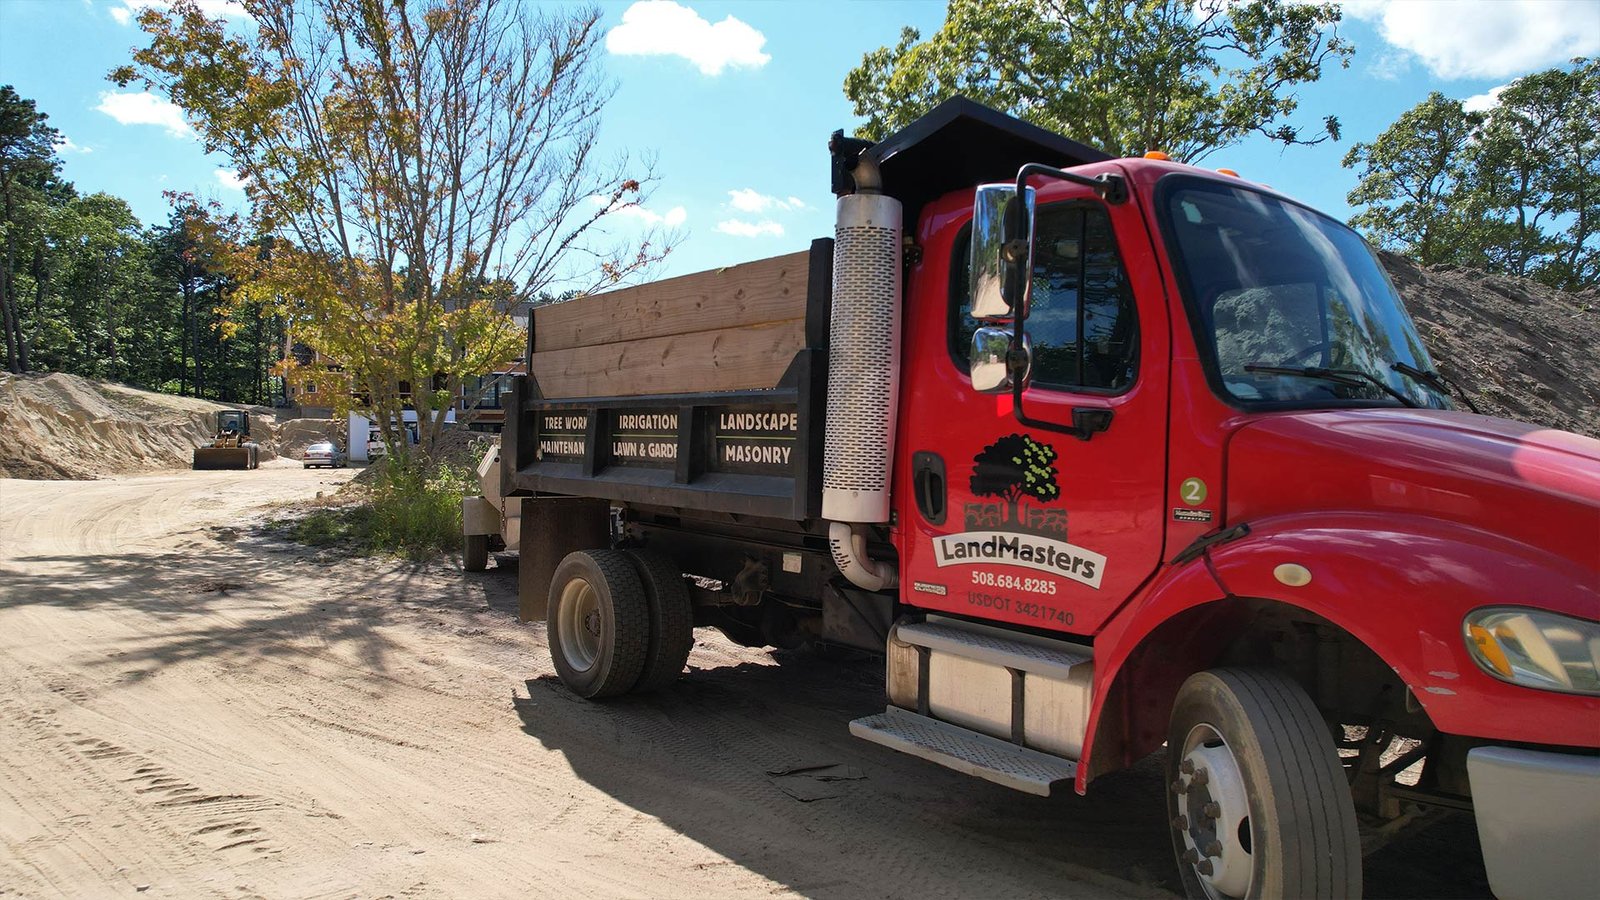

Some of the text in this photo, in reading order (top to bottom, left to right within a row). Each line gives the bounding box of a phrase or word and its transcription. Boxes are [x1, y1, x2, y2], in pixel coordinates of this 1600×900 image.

[545, 416, 562, 430] TREE
[619, 414, 678, 430] IRRIGATION
[720, 413, 798, 431] LANDSCAPE
[612, 441, 637, 457] LAWN
[639, 442, 646, 457] &
[725, 445, 792, 464] MASONRY
[1186, 480, 1201, 501] 2
[940, 535, 1096, 579] LandMasters
[971, 570, 1057, 596] 508.684.8285
[968, 591, 1075, 627] USDOT 3421740
